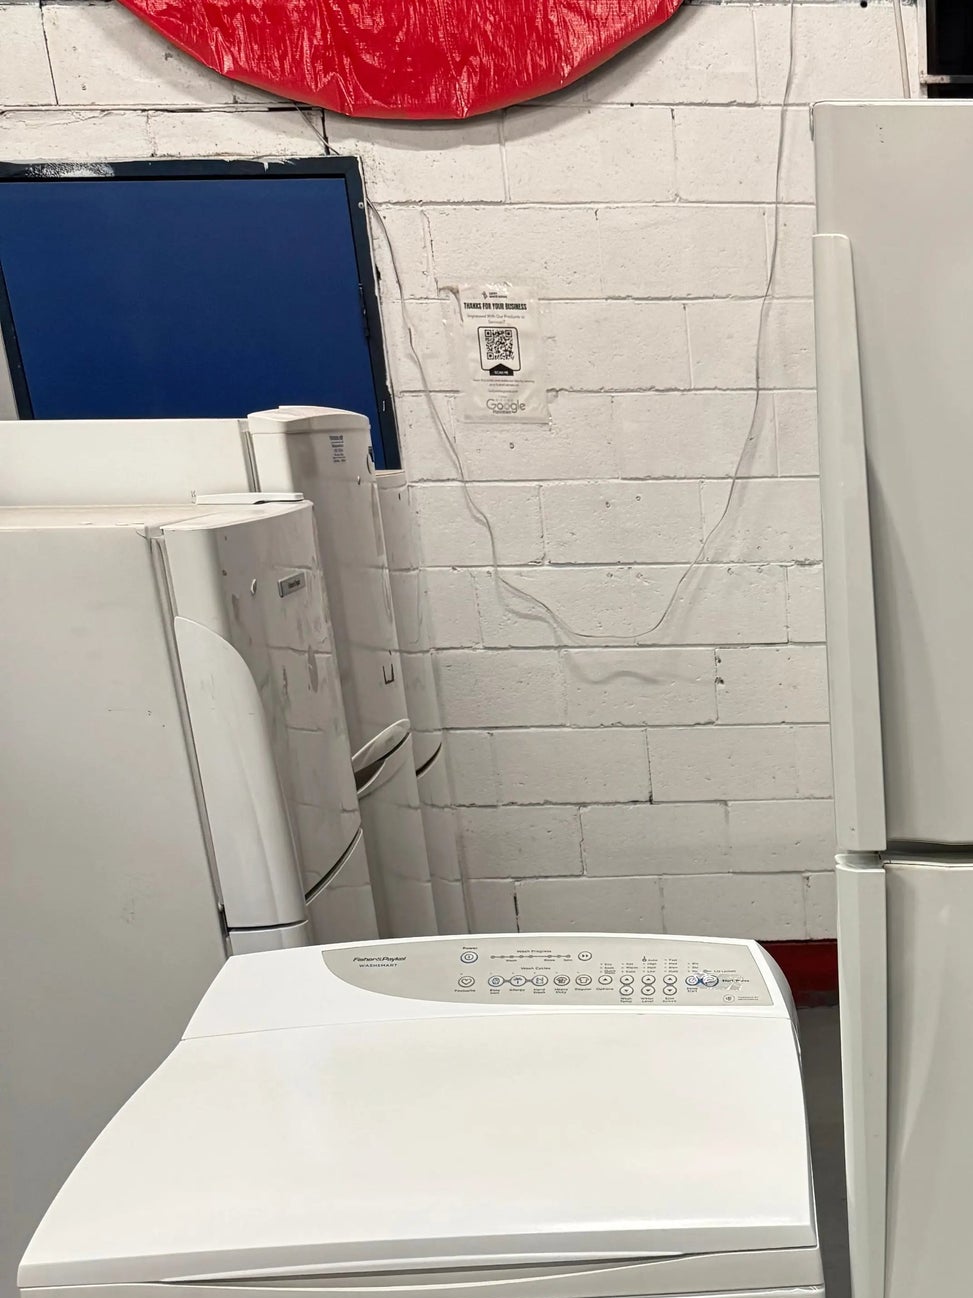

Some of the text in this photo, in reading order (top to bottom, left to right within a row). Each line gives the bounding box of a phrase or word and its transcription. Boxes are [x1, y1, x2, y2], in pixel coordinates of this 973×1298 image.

[464, 302, 527, 310] THANKS FOR YOUR BUSINESS
[486, 398, 526, 414] Google
